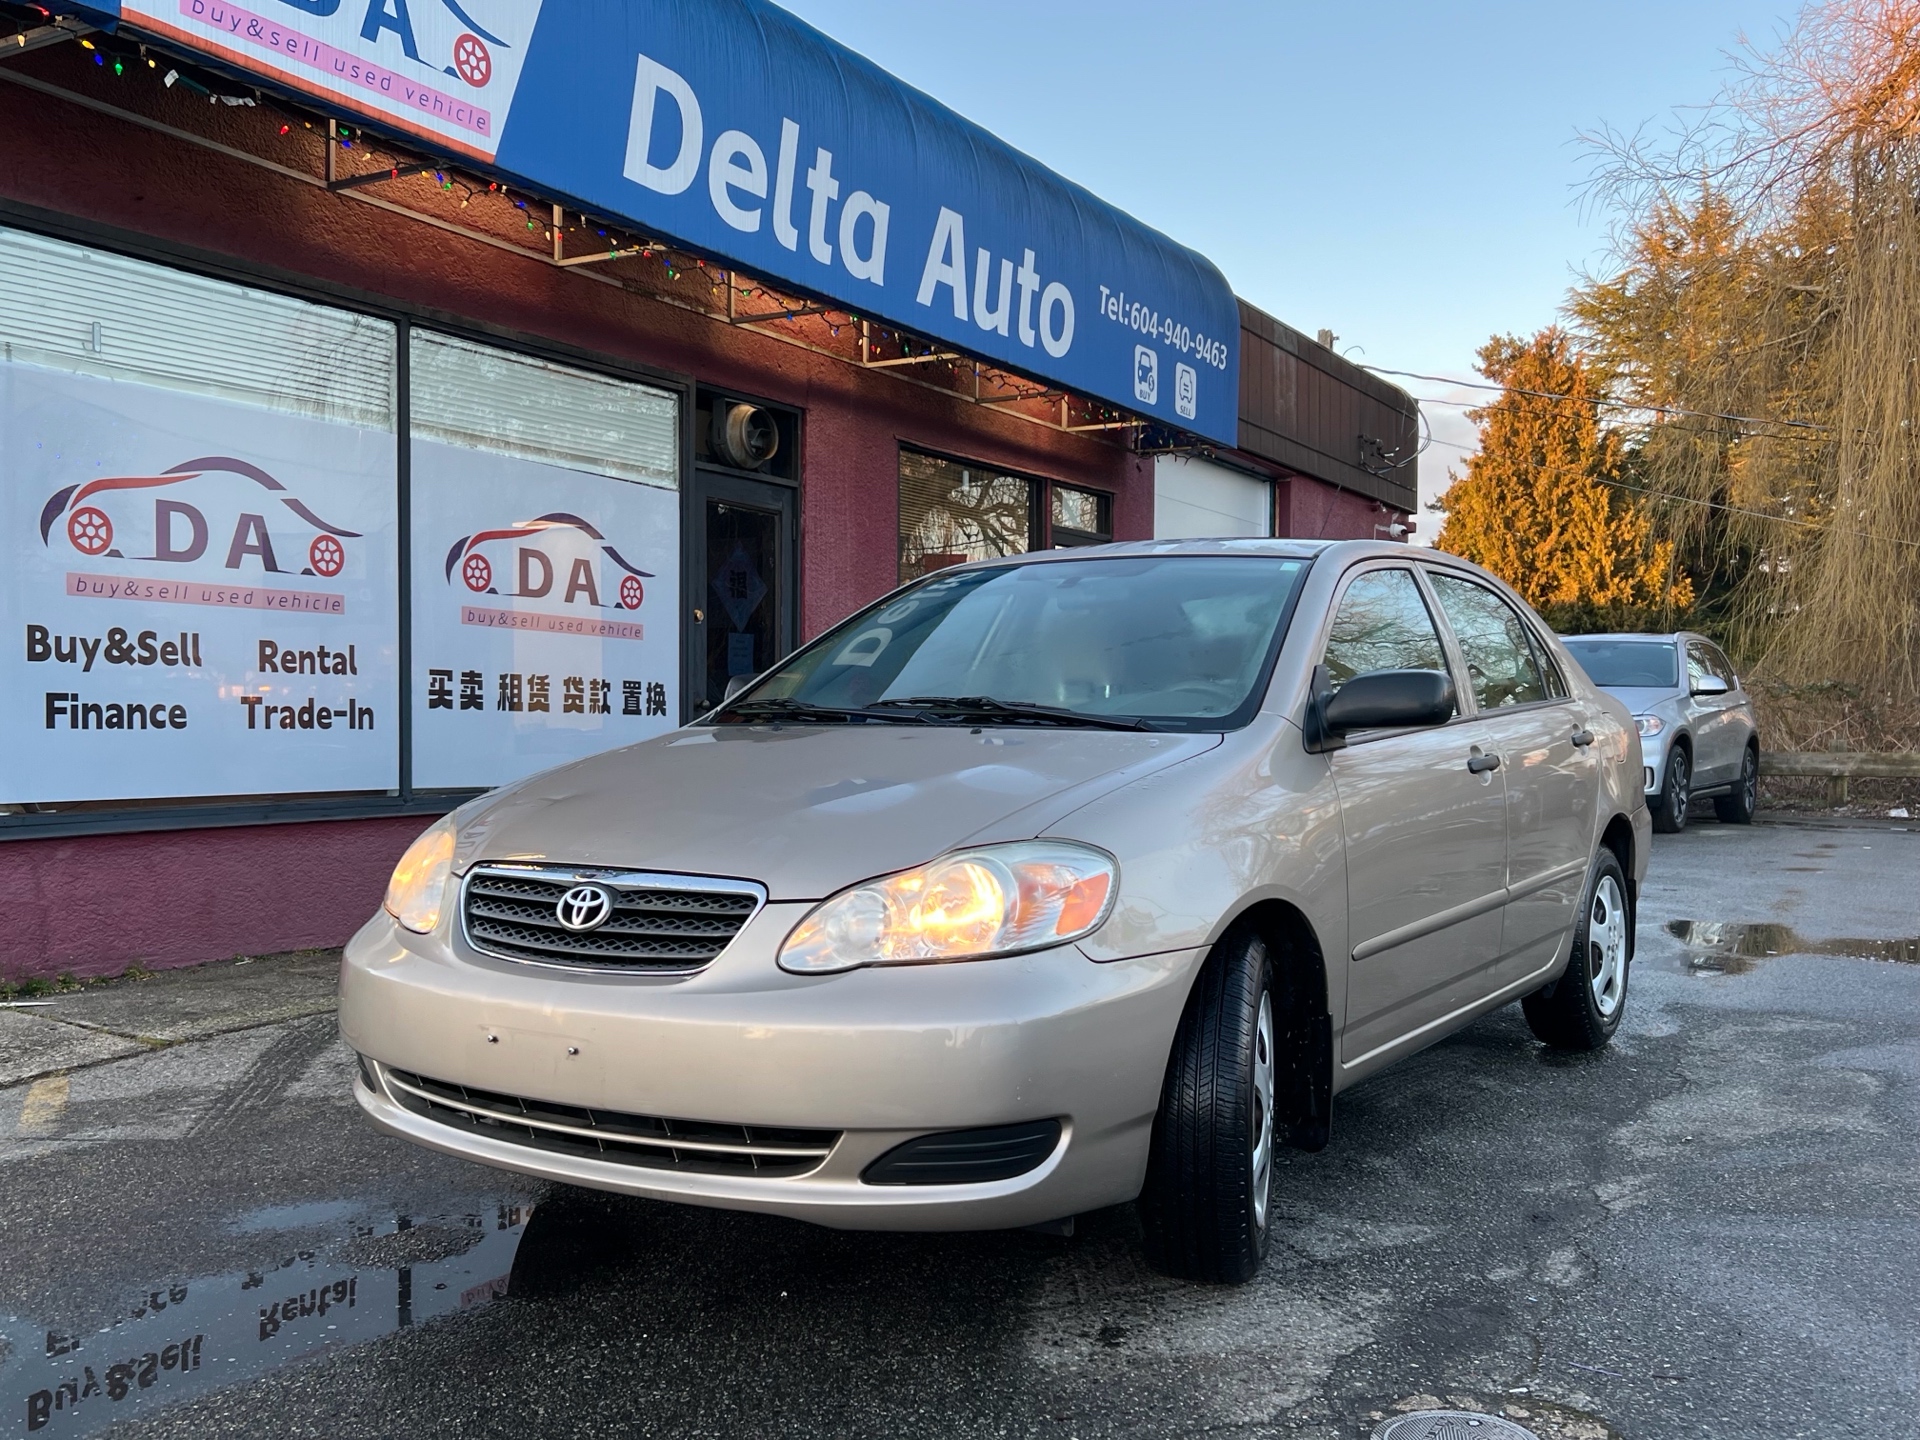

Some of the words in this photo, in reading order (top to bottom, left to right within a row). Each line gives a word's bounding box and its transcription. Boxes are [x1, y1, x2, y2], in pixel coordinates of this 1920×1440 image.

[192, 0, 319, 62] buy&sell
[334, 54, 392, 92] used
[405, 86, 487, 130] vehicle
[622, 52, 891, 287] Delta
[915, 205, 1076, 359] Auto
[1099, 284, 1228, 371] Tel:604-940-9463
[1139, 389, 1151, 401] BUY
[1179, 405, 1192, 417] SELL
[76, 576, 189, 600] buy&sell
[201, 588, 255, 606] used
[266, 592, 342, 612] vehicle
[467, 609, 541, 628] buy&sell
[548, 620, 584, 632] used
[590, 624, 642, 638] vehicle
[26, 623, 203, 673] Buy&Sell
[258, 639, 358, 676] Rental
[45, 691, 188, 730] Finance
[428, 668, 484, 711] 买卖
[497, 672, 550, 714] 租赁
[562, 676, 611, 715] 贷款
[622, 680, 667, 717] 置换
[240, 696, 374, 730] Trade-In
